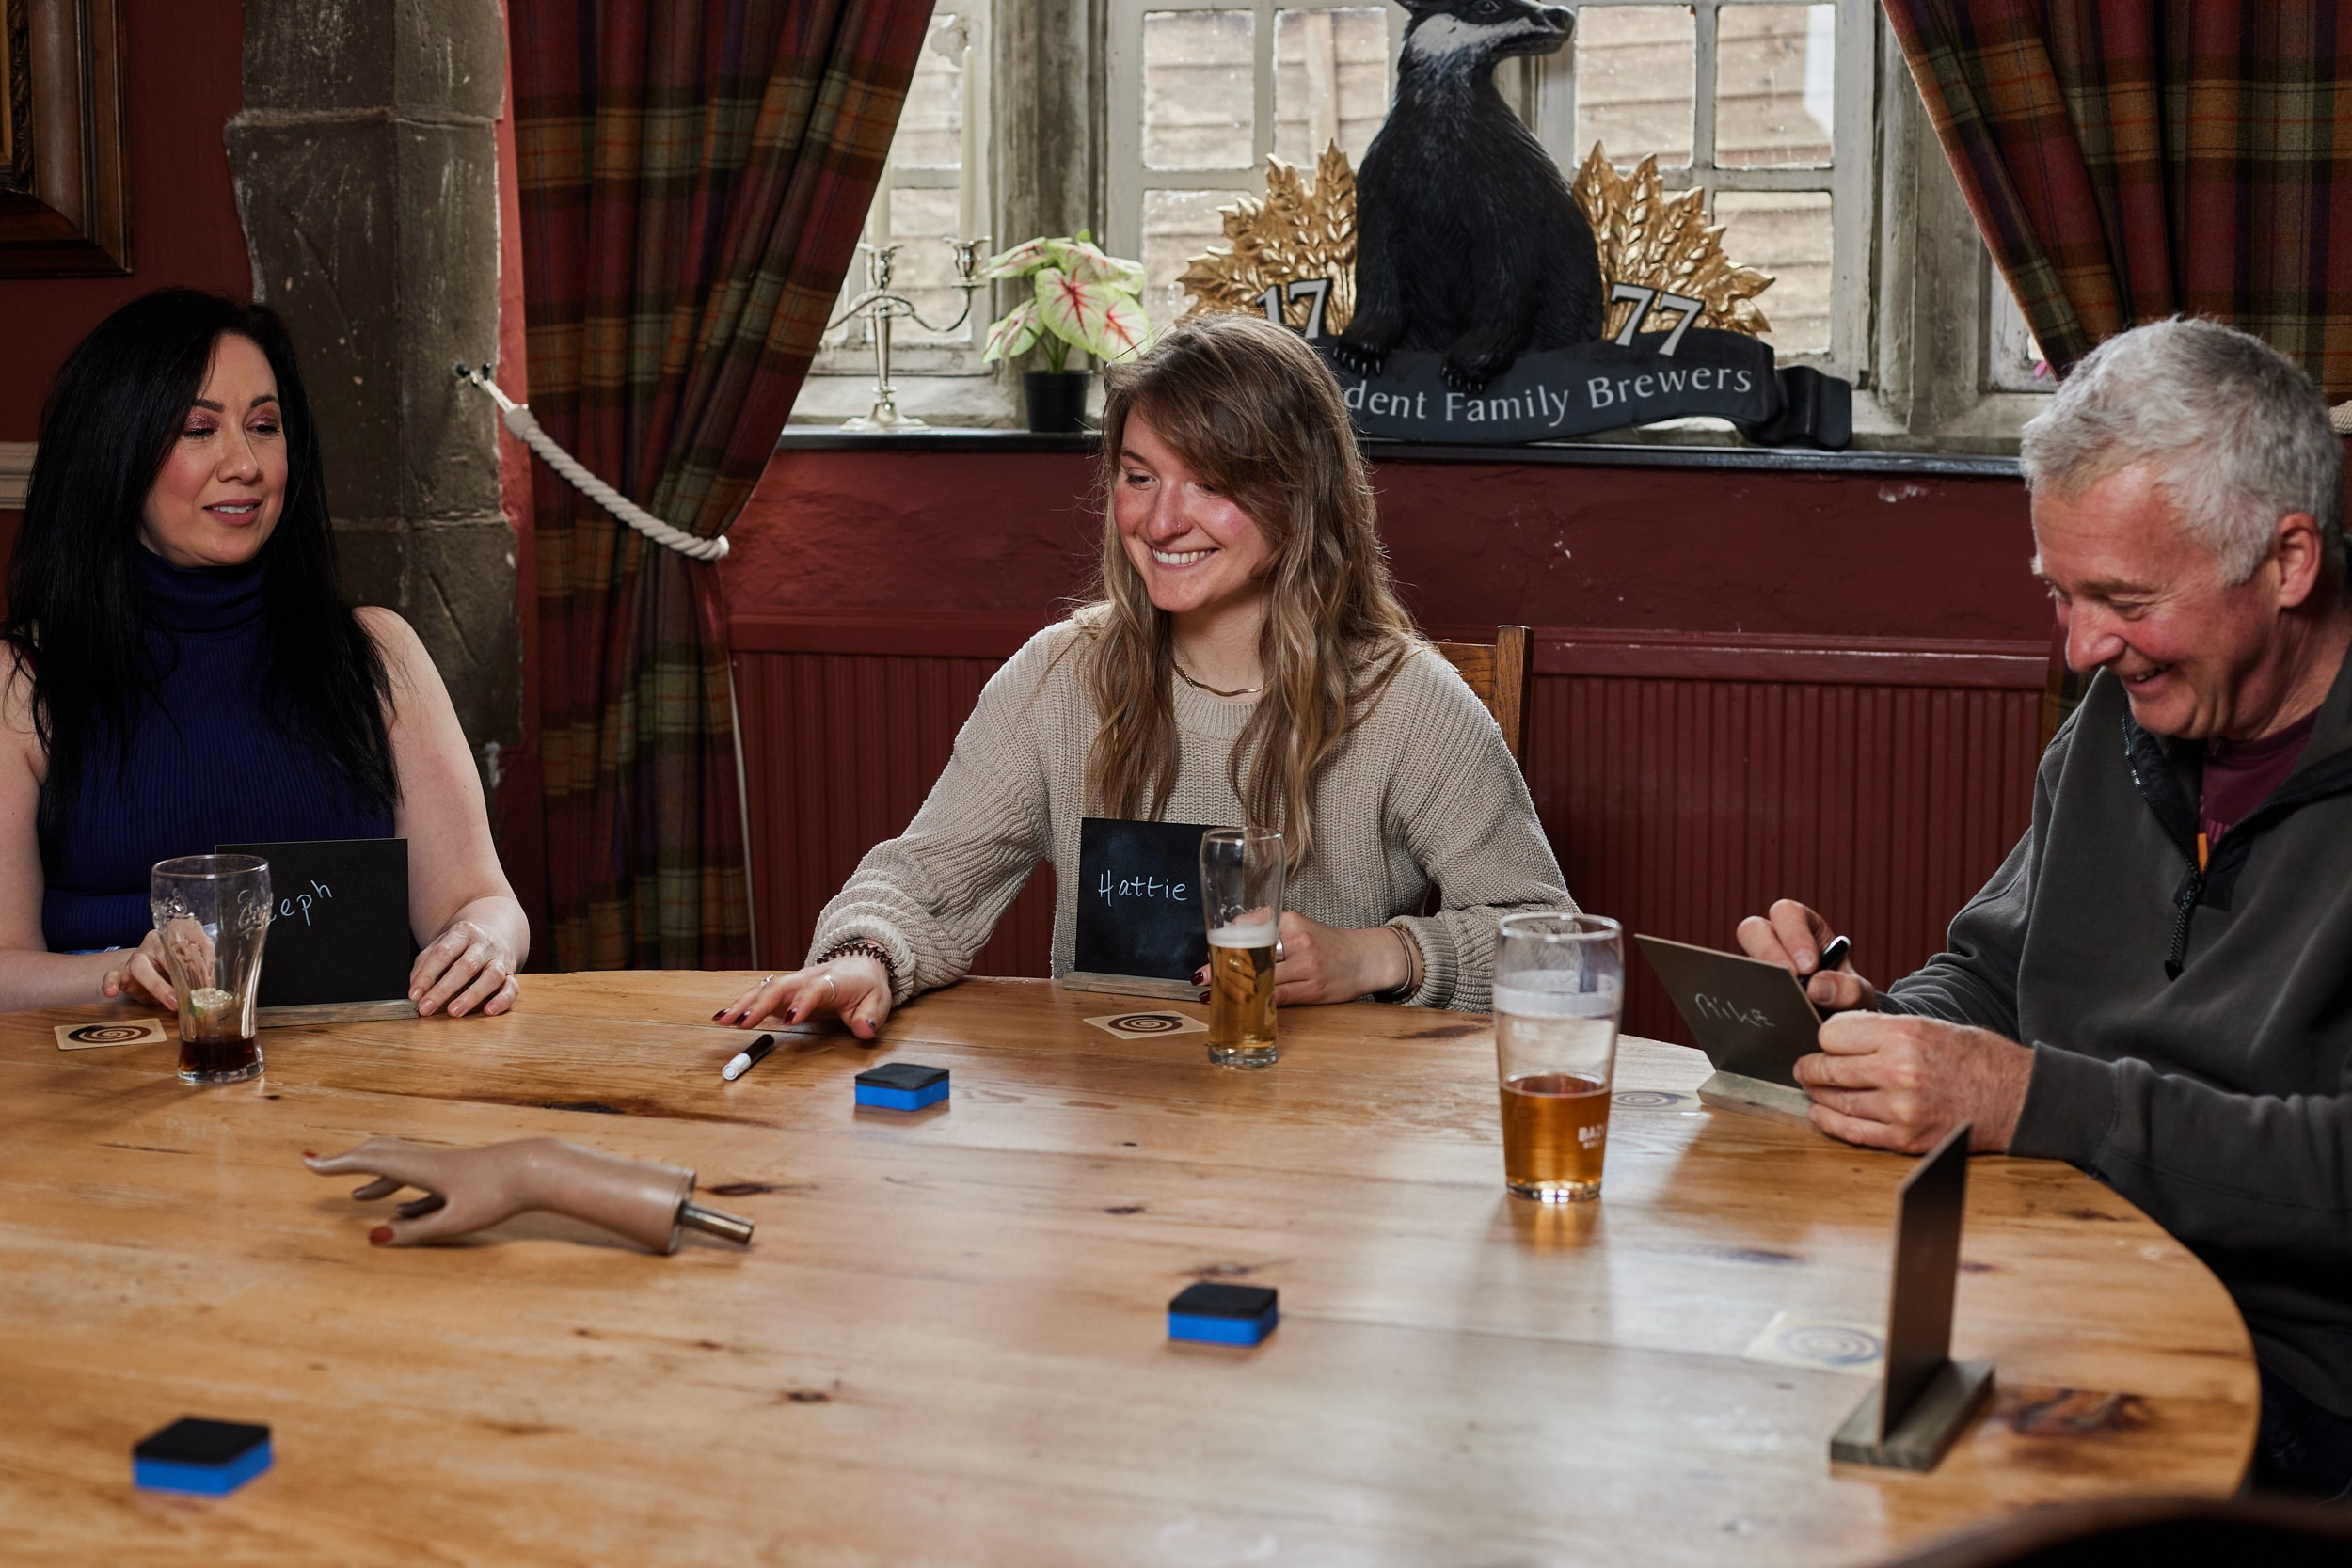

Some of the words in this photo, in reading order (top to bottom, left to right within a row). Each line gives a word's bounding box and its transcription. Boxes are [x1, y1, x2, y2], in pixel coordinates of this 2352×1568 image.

[1256, 279, 1328, 339] 17
[1611, 283, 1704, 356] 77
[1343, 379, 1428, 420] dent
[1445, 384, 1569, 427] Family
[1587, 367, 1752, 409] Brewers
[270, 879, 333, 927] eph
[1098, 869, 1188, 907] Hattie
